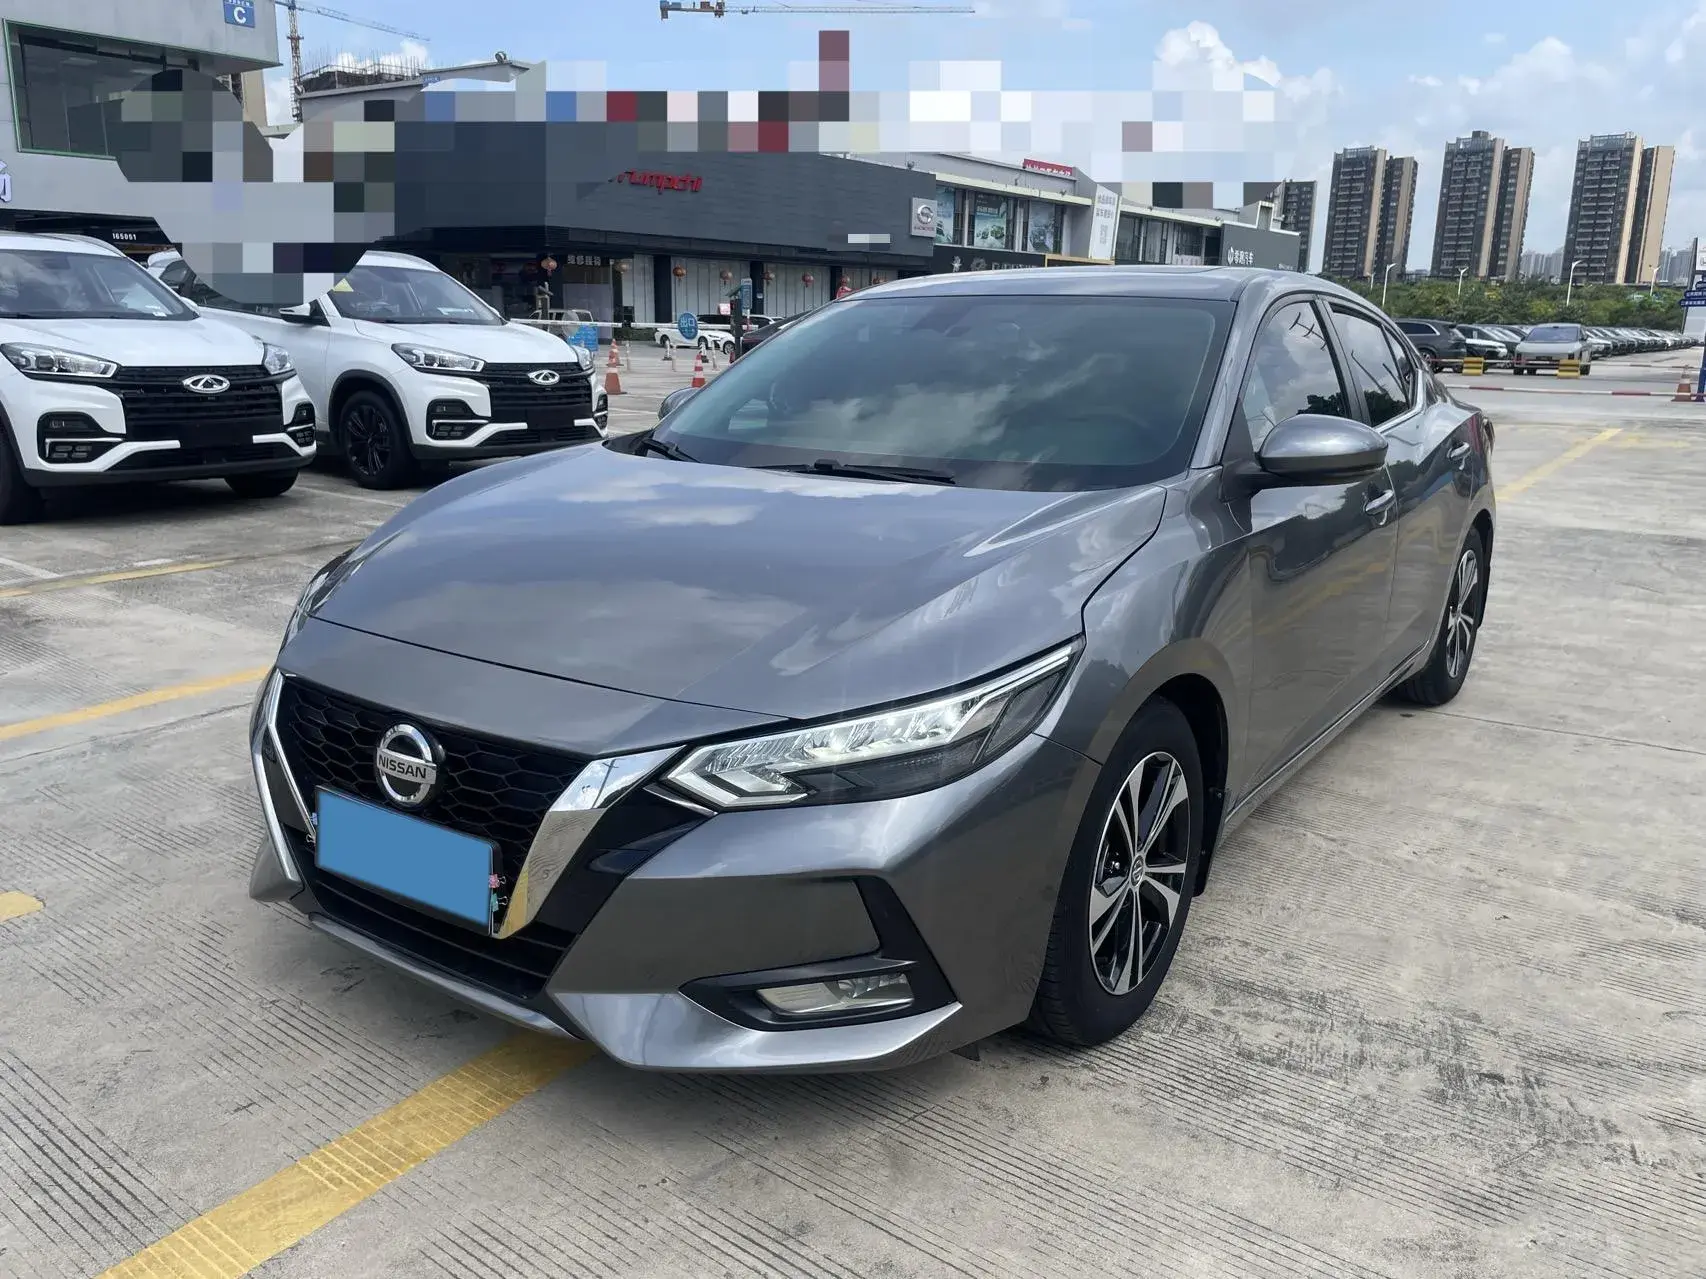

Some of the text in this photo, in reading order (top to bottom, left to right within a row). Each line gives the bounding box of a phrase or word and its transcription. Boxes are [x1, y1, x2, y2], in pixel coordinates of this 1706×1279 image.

[233, 6, 247, 24] C
[615, 168, 703, 193] rumpchi
[680, 317, 695, 328] 出口
[378, 756, 427, 779] NISSAN
